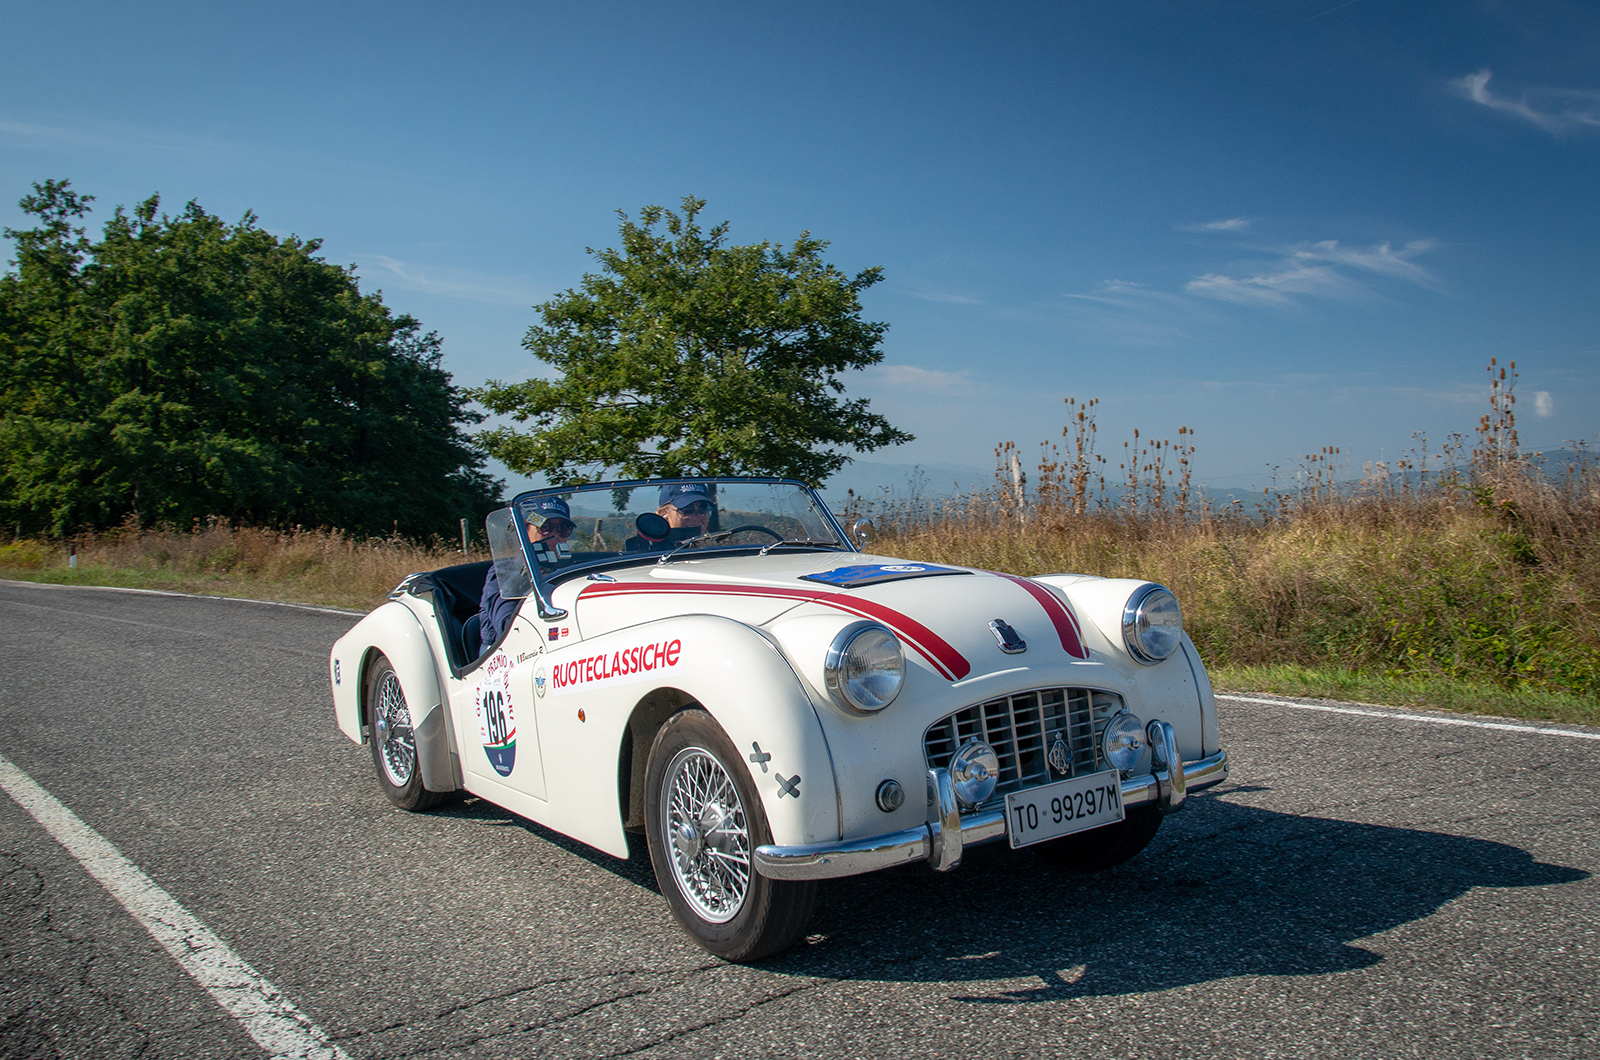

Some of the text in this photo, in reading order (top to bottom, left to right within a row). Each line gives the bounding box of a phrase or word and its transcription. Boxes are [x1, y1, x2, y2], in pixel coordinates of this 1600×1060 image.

[487, 654, 508, 678] PREMIO
[483, 690, 507, 746] 196
[1013, 784, 1119, 833] TO 99297M
